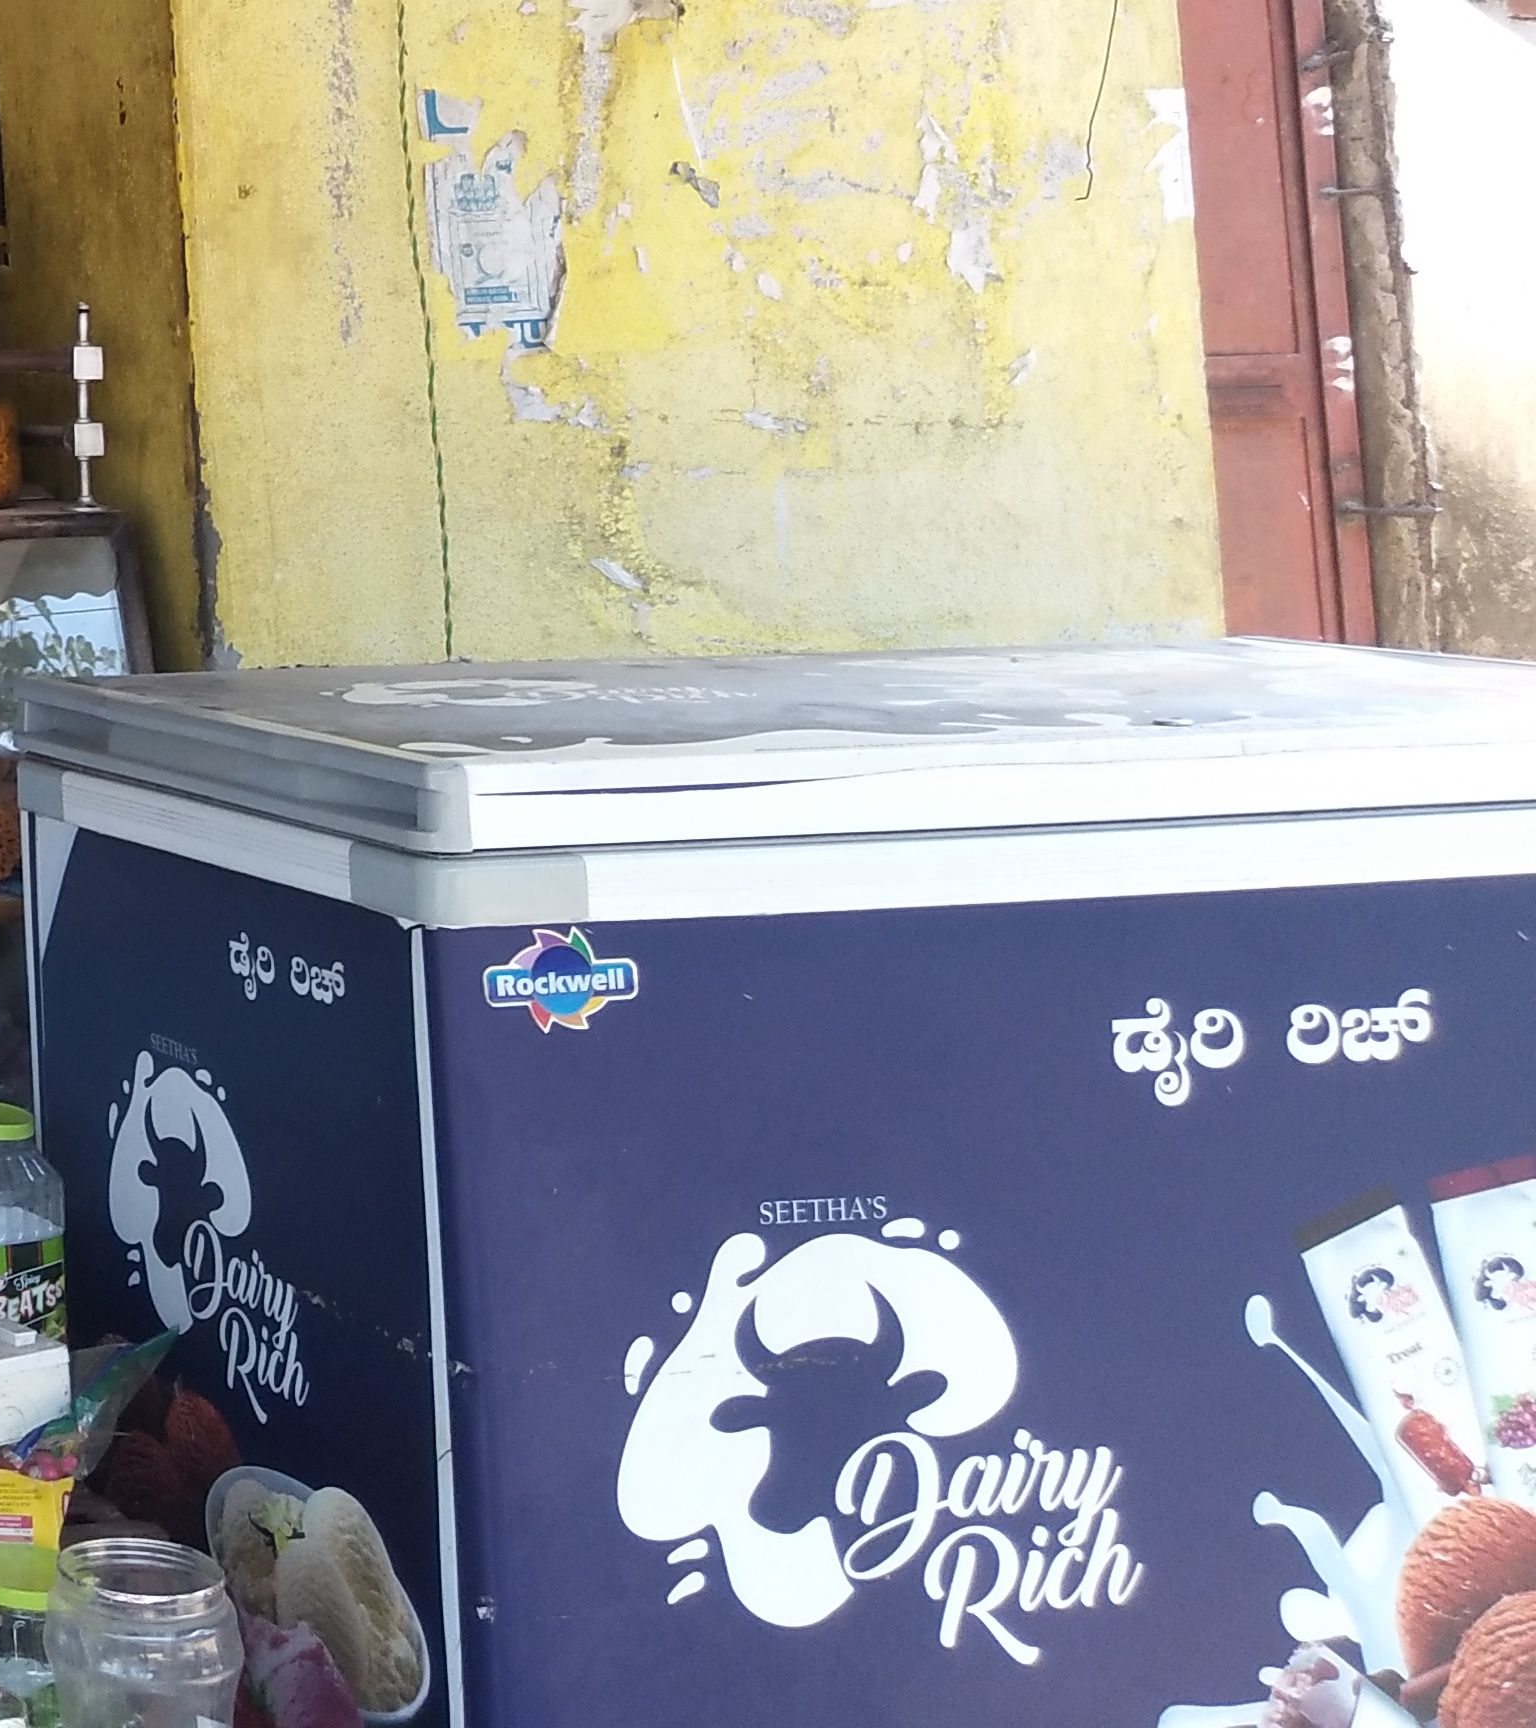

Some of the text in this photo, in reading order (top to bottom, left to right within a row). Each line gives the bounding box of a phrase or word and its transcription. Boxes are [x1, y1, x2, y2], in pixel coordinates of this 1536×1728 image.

[228, 931, 276, 1001] ಡೈರಿ
[496, 967, 626, 997] Rockwell
[1110, 988, 1433, 1108] ಡೈರಿ ರಿಚ್
[184, 1219, 300, 1346] Dairy
[218, 1309, 310, 1425] Rich
[1386, 1341, 1424, 1365] Treat
[834, 1428, 1125, 1582] Dairy
[925, 1507, 1143, 1664] Rich
